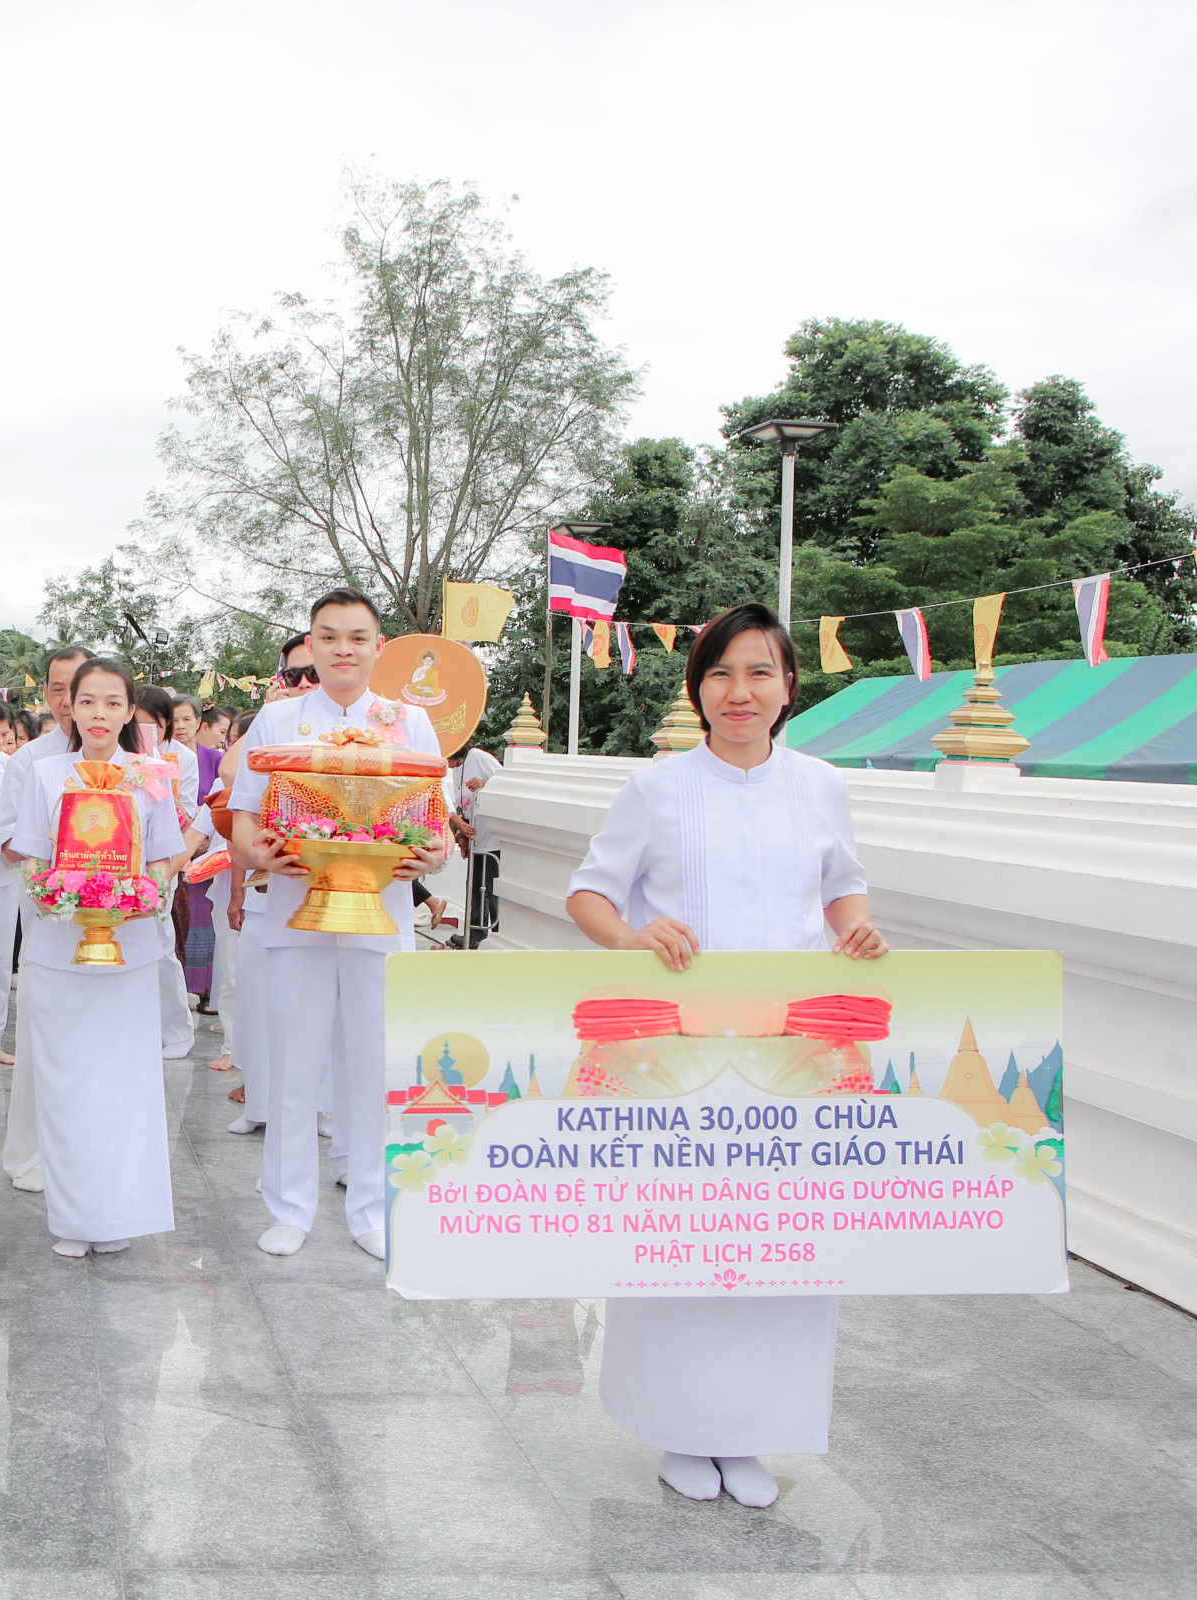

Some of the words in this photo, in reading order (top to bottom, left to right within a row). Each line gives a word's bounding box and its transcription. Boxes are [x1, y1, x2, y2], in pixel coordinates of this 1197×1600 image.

[558, 1107, 690, 1130] KATHINA
[700, 1105, 797, 1136] 30,000
[815, 1099, 897, 1129] CHÙA
[488, 1138, 578, 1168] ĐOÀN
[591, 1134, 643, 1167] KẾT
[655, 1134, 714, 1167] NỀN
[727, 1136, 802, 1171] PHẬT
[812, 1135, 885, 1165] GIÁO
[895, 1134, 962, 1164] THÁI
[476, 1179, 546, 1203] ĐOÀN
[555, 1178, 585, 1206] ĐỆ
[594, 1176, 628, 1202] TỬ
[637, 1178, 693, 1201] KÍNH
[703, 1177, 769, 1201] DÂNG
[778, 1177, 844, 1200] CÚNG
[854, 1176, 943, 1199] DƯỜNG
[953, 1175, 1014, 1198] PHÁP
[441, 1210, 520, 1234] MỪNG
[529, 1214, 579, 1237] THỌ
[588, 1214, 614, 1233] 81
[624, 1209, 680, 1232] NĂM
[690, 1213, 769, 1232] LUANG
[778, 1212, 825, 1231] POR
[834, 1210, 1003, 1230] DHAMMAJAYO
[635, 1240, 695, 1267] PHẬT
[703, 1244, 751, 1267] LỊCH
[761, 1243, 815, 1262] 2568
